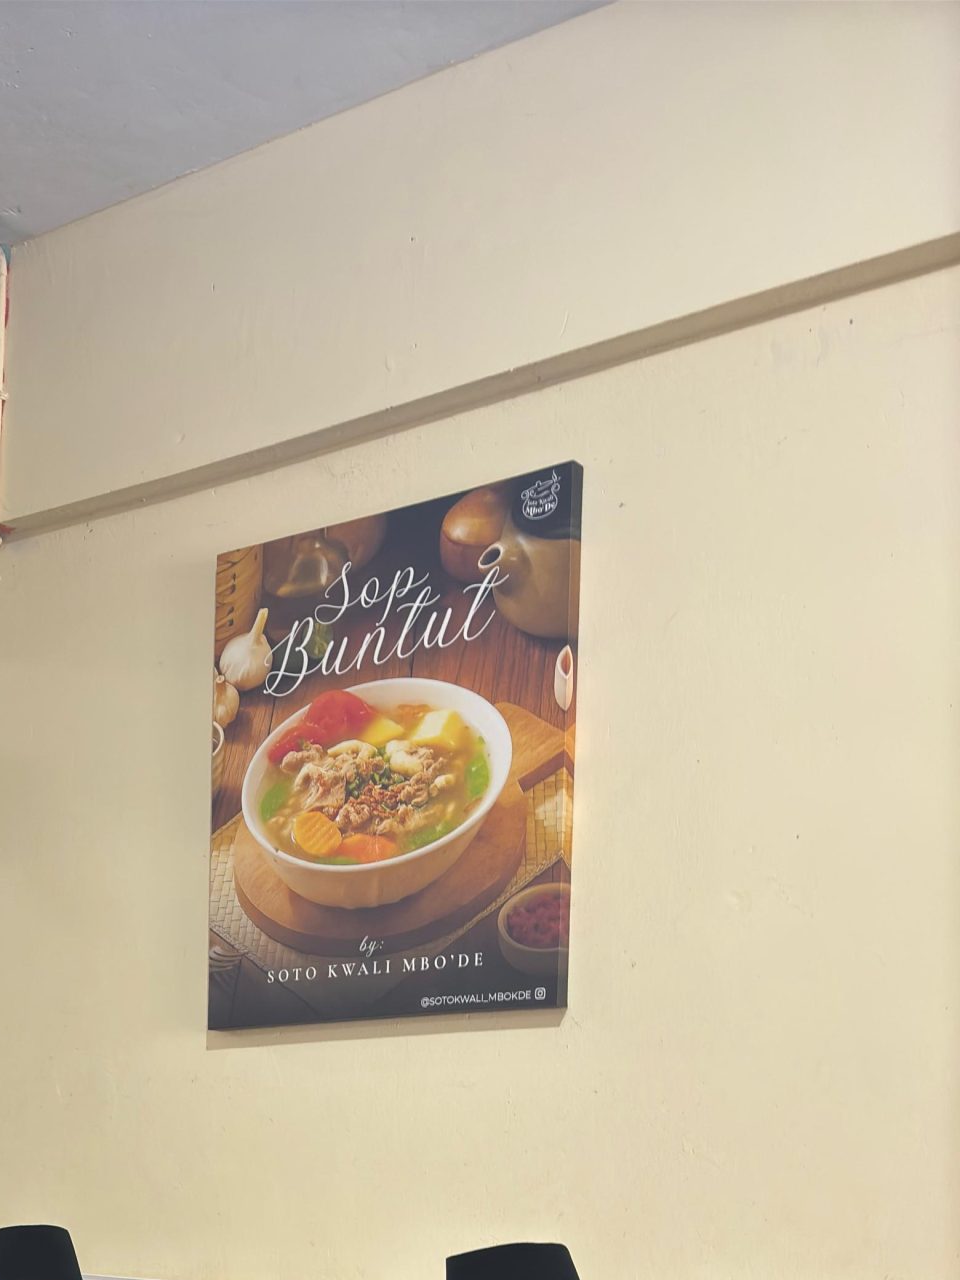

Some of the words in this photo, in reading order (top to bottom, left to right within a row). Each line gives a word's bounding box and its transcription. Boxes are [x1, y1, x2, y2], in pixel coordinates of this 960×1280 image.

[314, 561, 430, 626] Sop
[263, 566, 510, 697] Buntut
[358, 935, 384, 957] by:
[266, 966, 318, 984] SOTO
[327, 959, 391, 979] KWALI
[402, 952, 484, 973] MBO'DE
[420, 989, 531, 1009] @SOTOKWALI_MBOKDE
